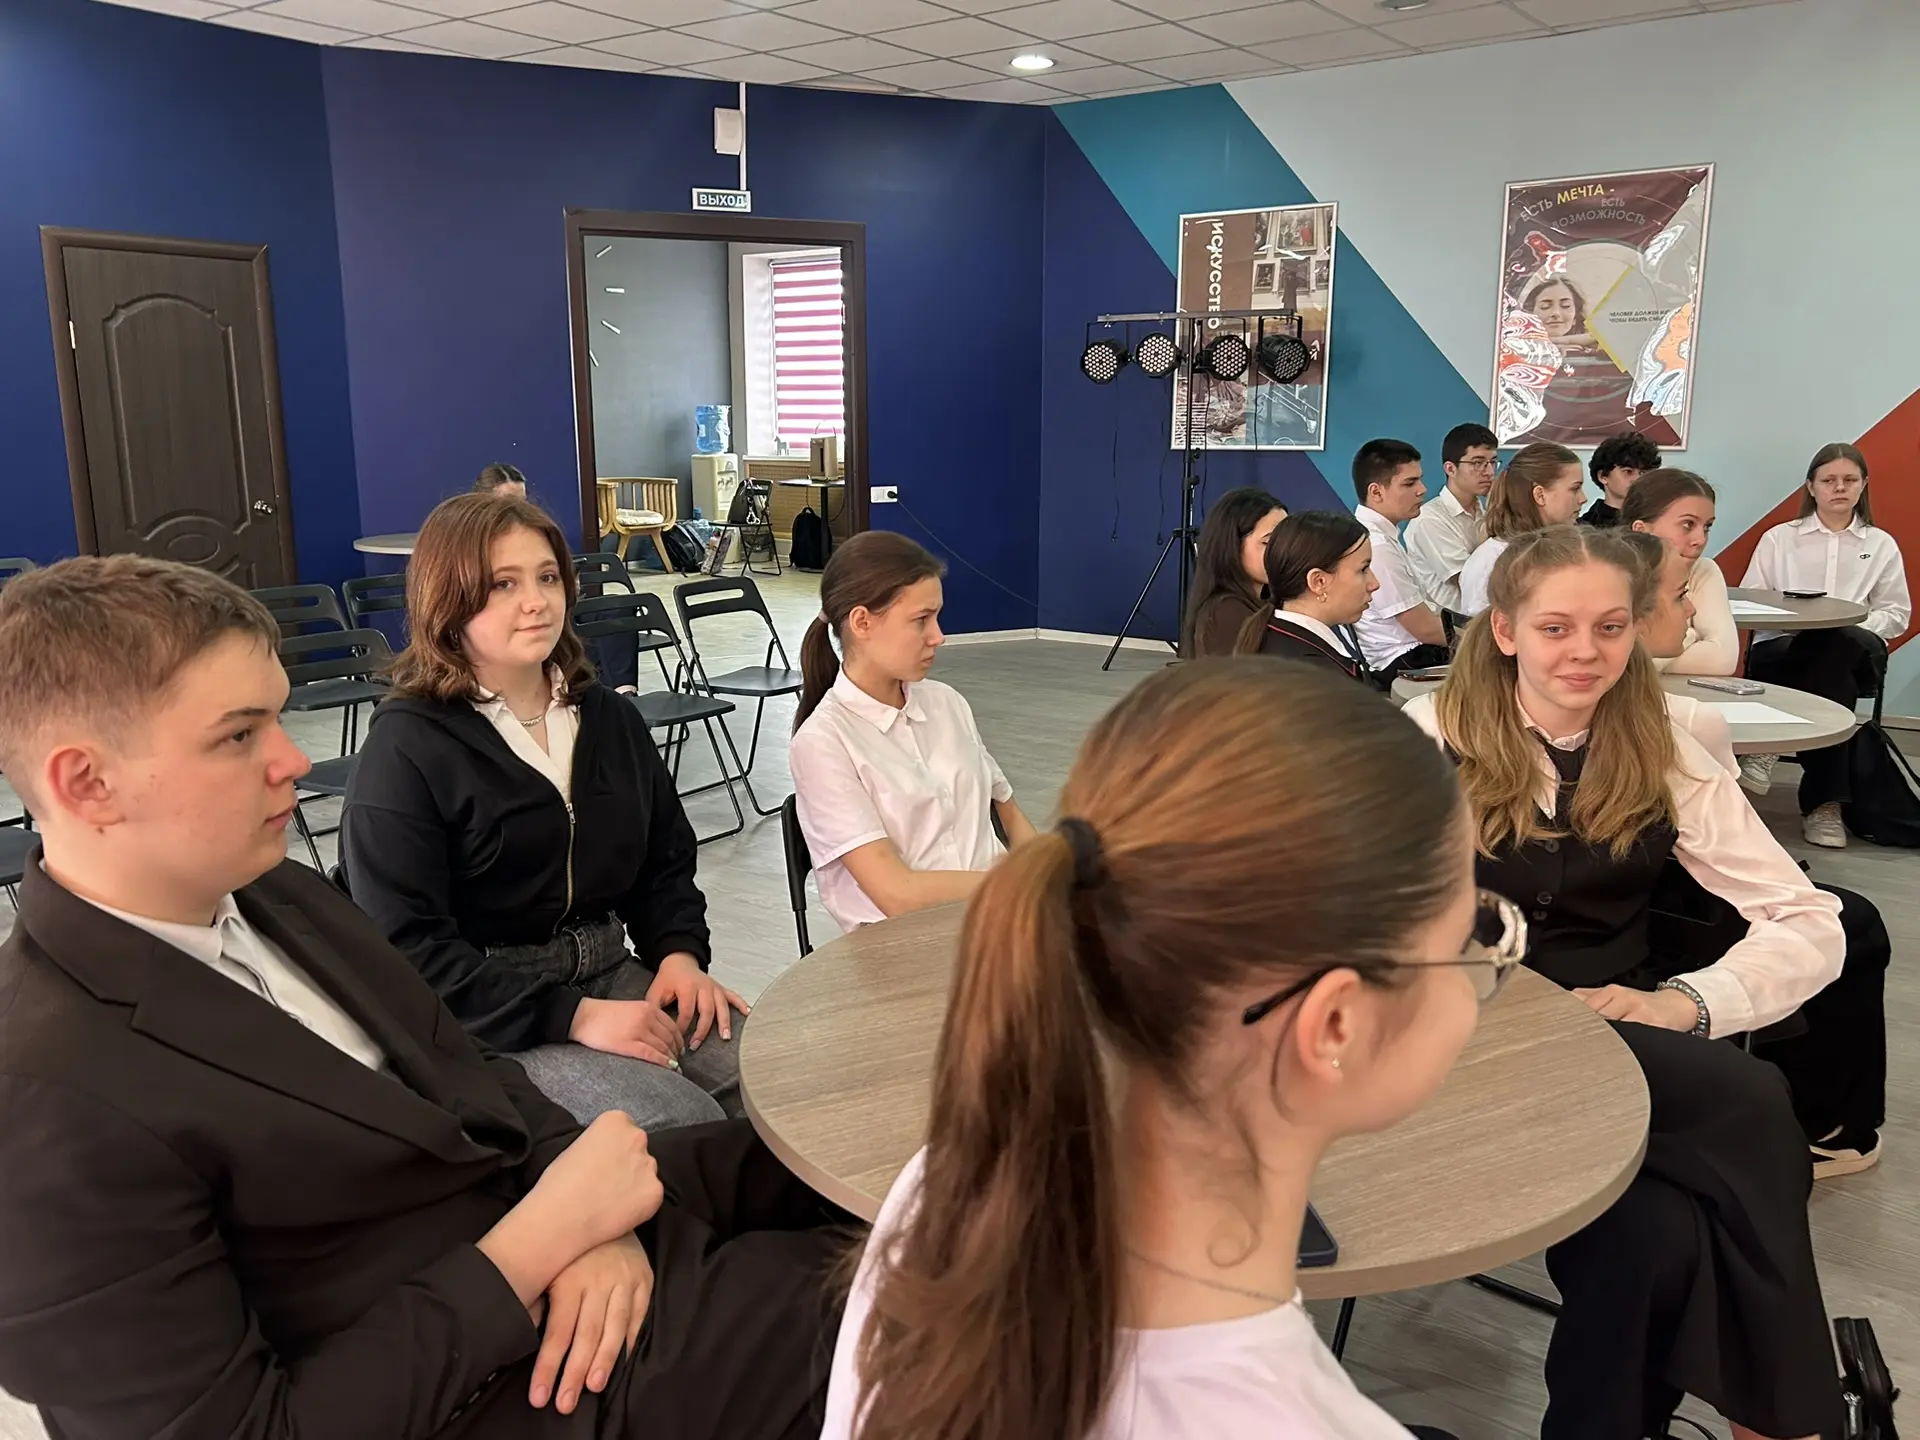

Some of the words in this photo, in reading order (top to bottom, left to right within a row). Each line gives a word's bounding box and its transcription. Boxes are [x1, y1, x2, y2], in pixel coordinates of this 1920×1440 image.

[700, 194, 746, 207] ВЫХОД
[1520, 199, 1553, 222] ЕСТЬ
[1557, 184, 1604, 204] МЕЧТА
[1601, 197, 1625, 207] ЕСТЬ
[1552, 208, 1646, 228] ВОЗМОЖНОСТЬ
